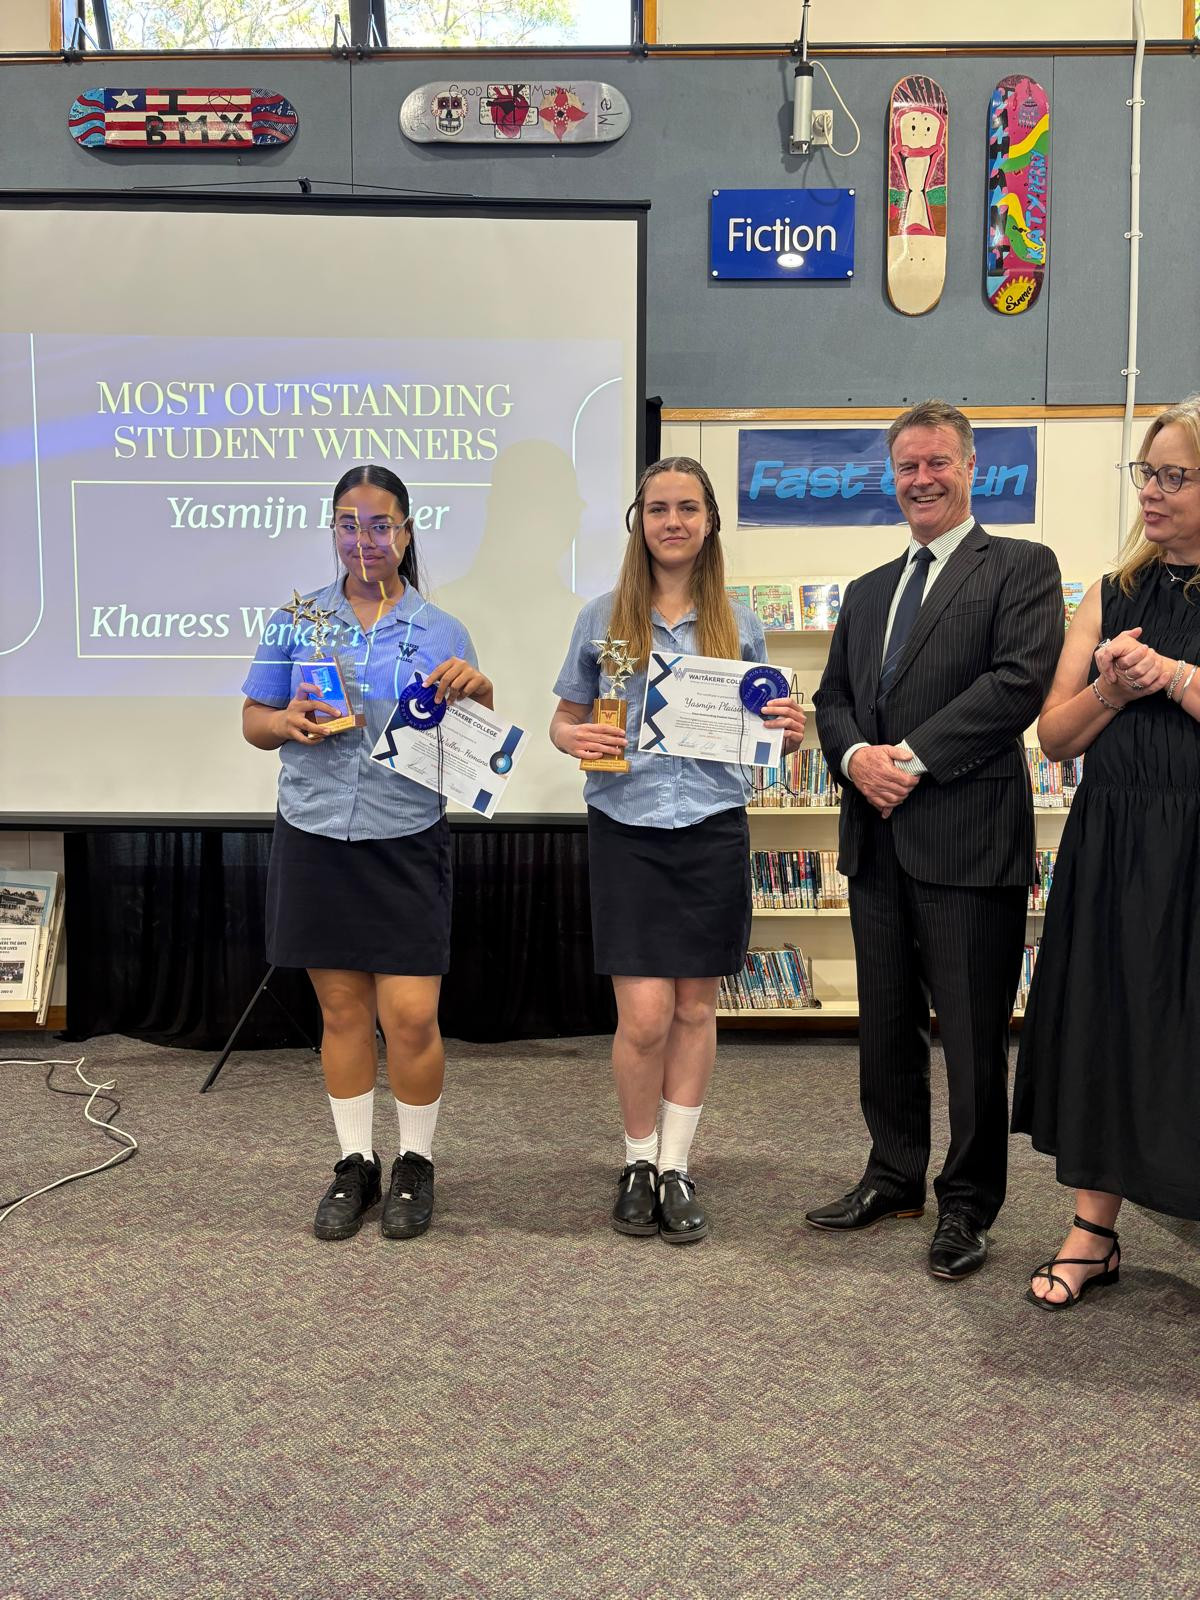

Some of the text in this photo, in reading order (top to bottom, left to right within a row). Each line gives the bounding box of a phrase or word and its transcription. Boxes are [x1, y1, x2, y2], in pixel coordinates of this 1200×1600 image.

[146, 114, 244, 144] BMX
[728, 217, 837, 252] Fiction
[1026, 194, 1046, 259] KATY
[96, 381, 515, 419] MOST OUTSTANDING
[113, 425, 499, 462] STUDENT WINNERS
[749, 460, 868, 500] Fast
[970, 464, 1029, 497] un
[167, 496, 308, 539] Yasmijn
[90, 604, 230, 638] Kharess
[446, 706, 473, 724] AITĀKERE
[472, 721, 498, 738] COLLEGE
[685, 697, 716, 711] Yasmijn
